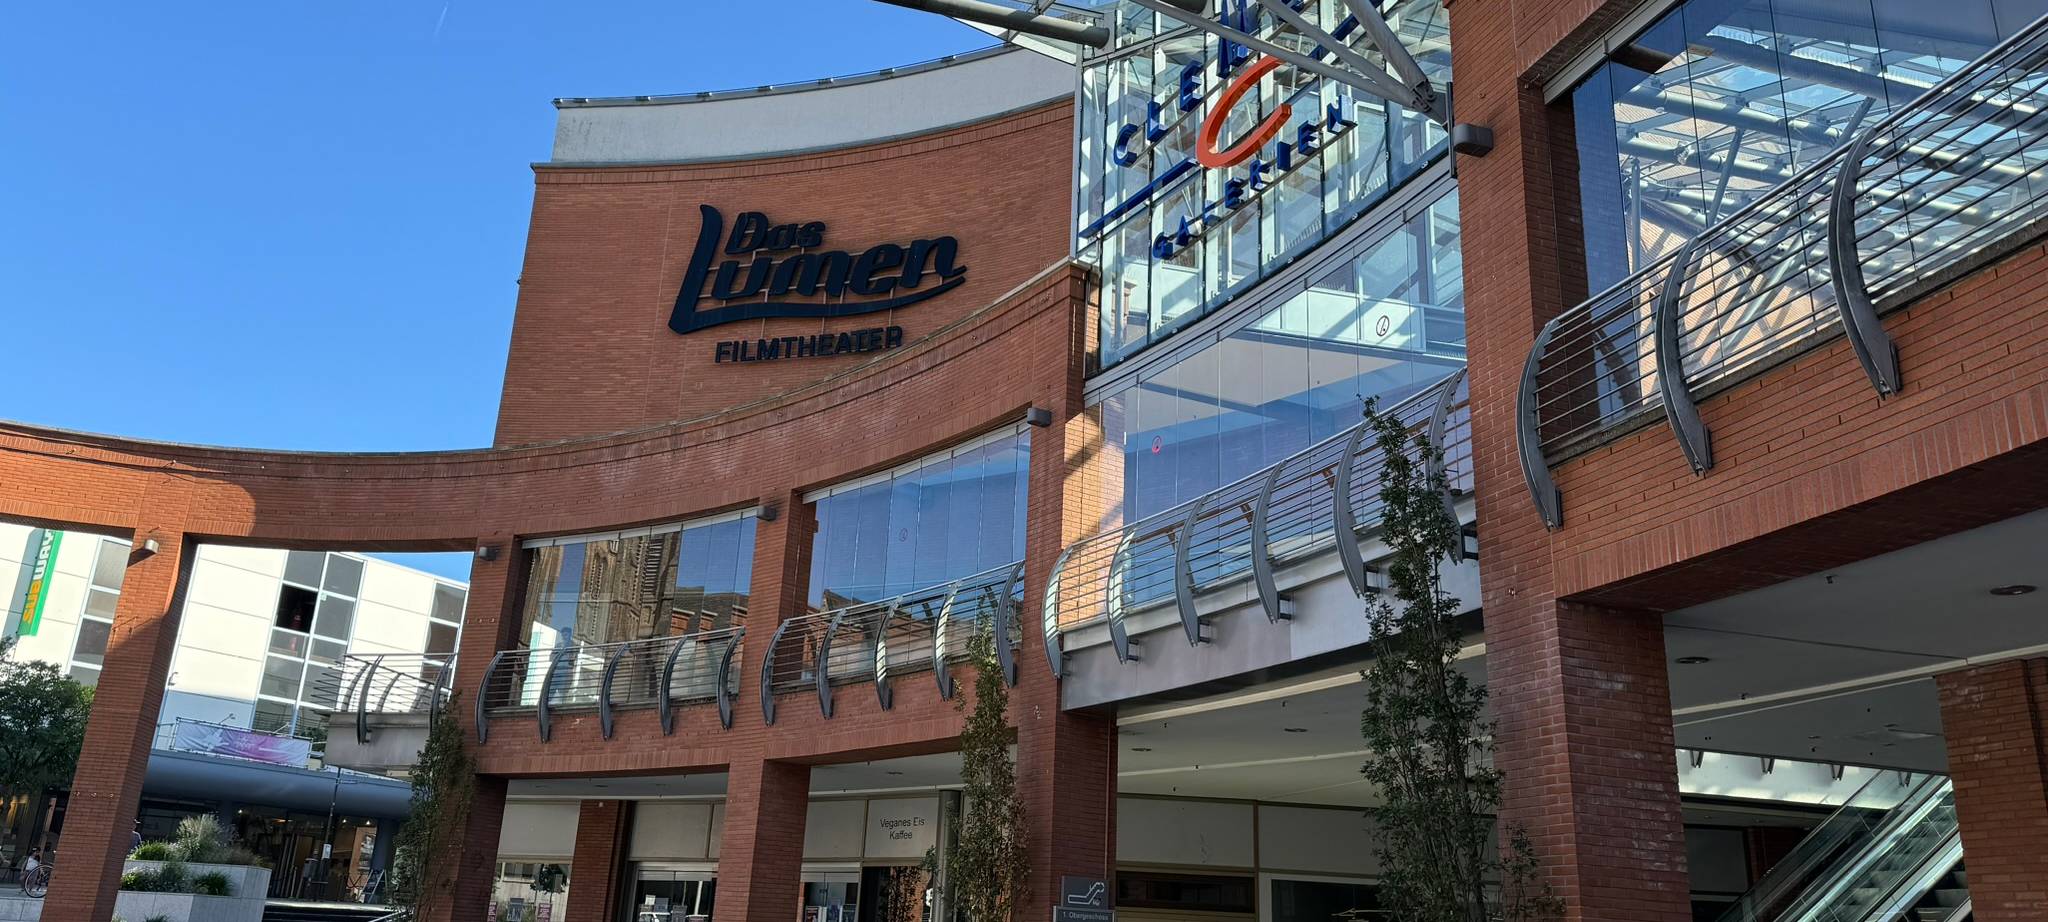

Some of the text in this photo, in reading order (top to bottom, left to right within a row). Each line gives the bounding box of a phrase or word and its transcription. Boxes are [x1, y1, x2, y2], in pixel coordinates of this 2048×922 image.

[1153, 95, 1357, 260] GALERIEN
[725, 211, 826, 255] Das
[668, 204, 967, 335] Lumen
[715, 326, 903, 363] FILMTHEATER
[880, 817, 925, 829] Veganes Eis
[889, 830, 913, 840] Kaffee
